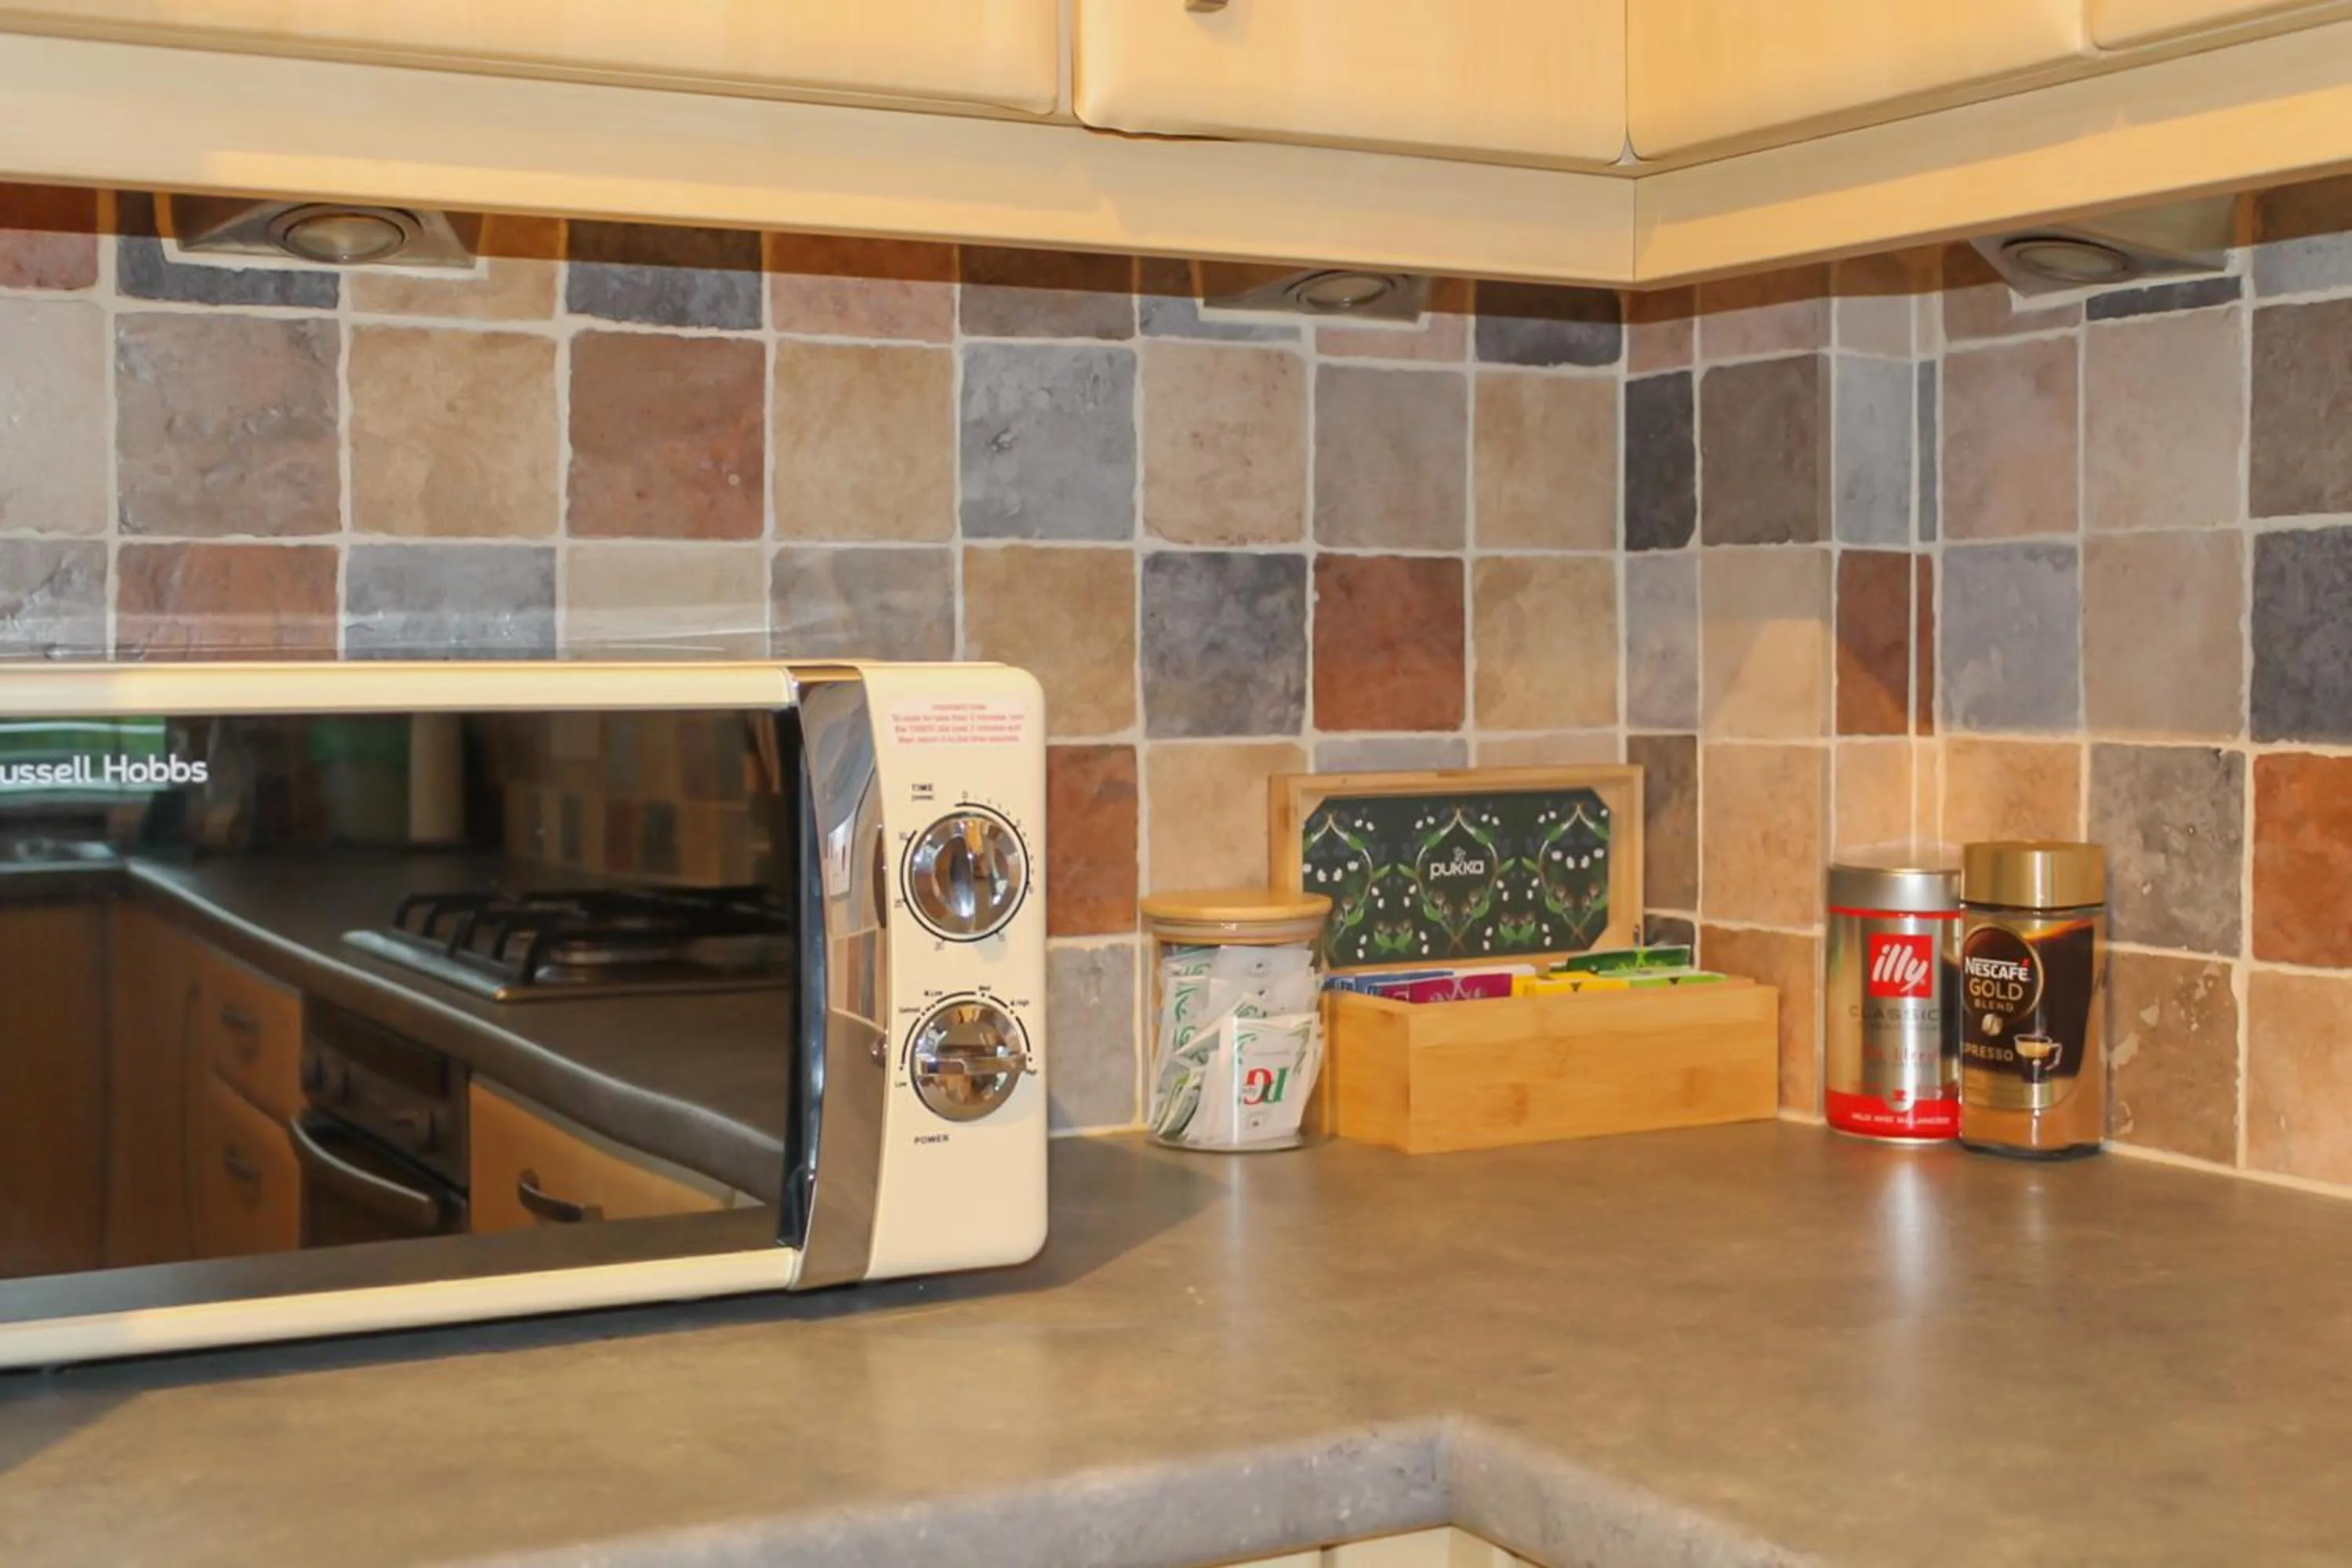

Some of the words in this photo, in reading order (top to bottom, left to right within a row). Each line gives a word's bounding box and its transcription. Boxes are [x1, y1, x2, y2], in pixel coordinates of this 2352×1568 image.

[0, 755, 93, 783] ussell
[103, 753, 209, 783] Hobbs
[1429, 860, 1485, 880] pukka
[1872, 943, 1929, 993] illy
[1969, 978, 2024, 1001] GOLD
[1974, 998, 2015, 1012] BLEND
